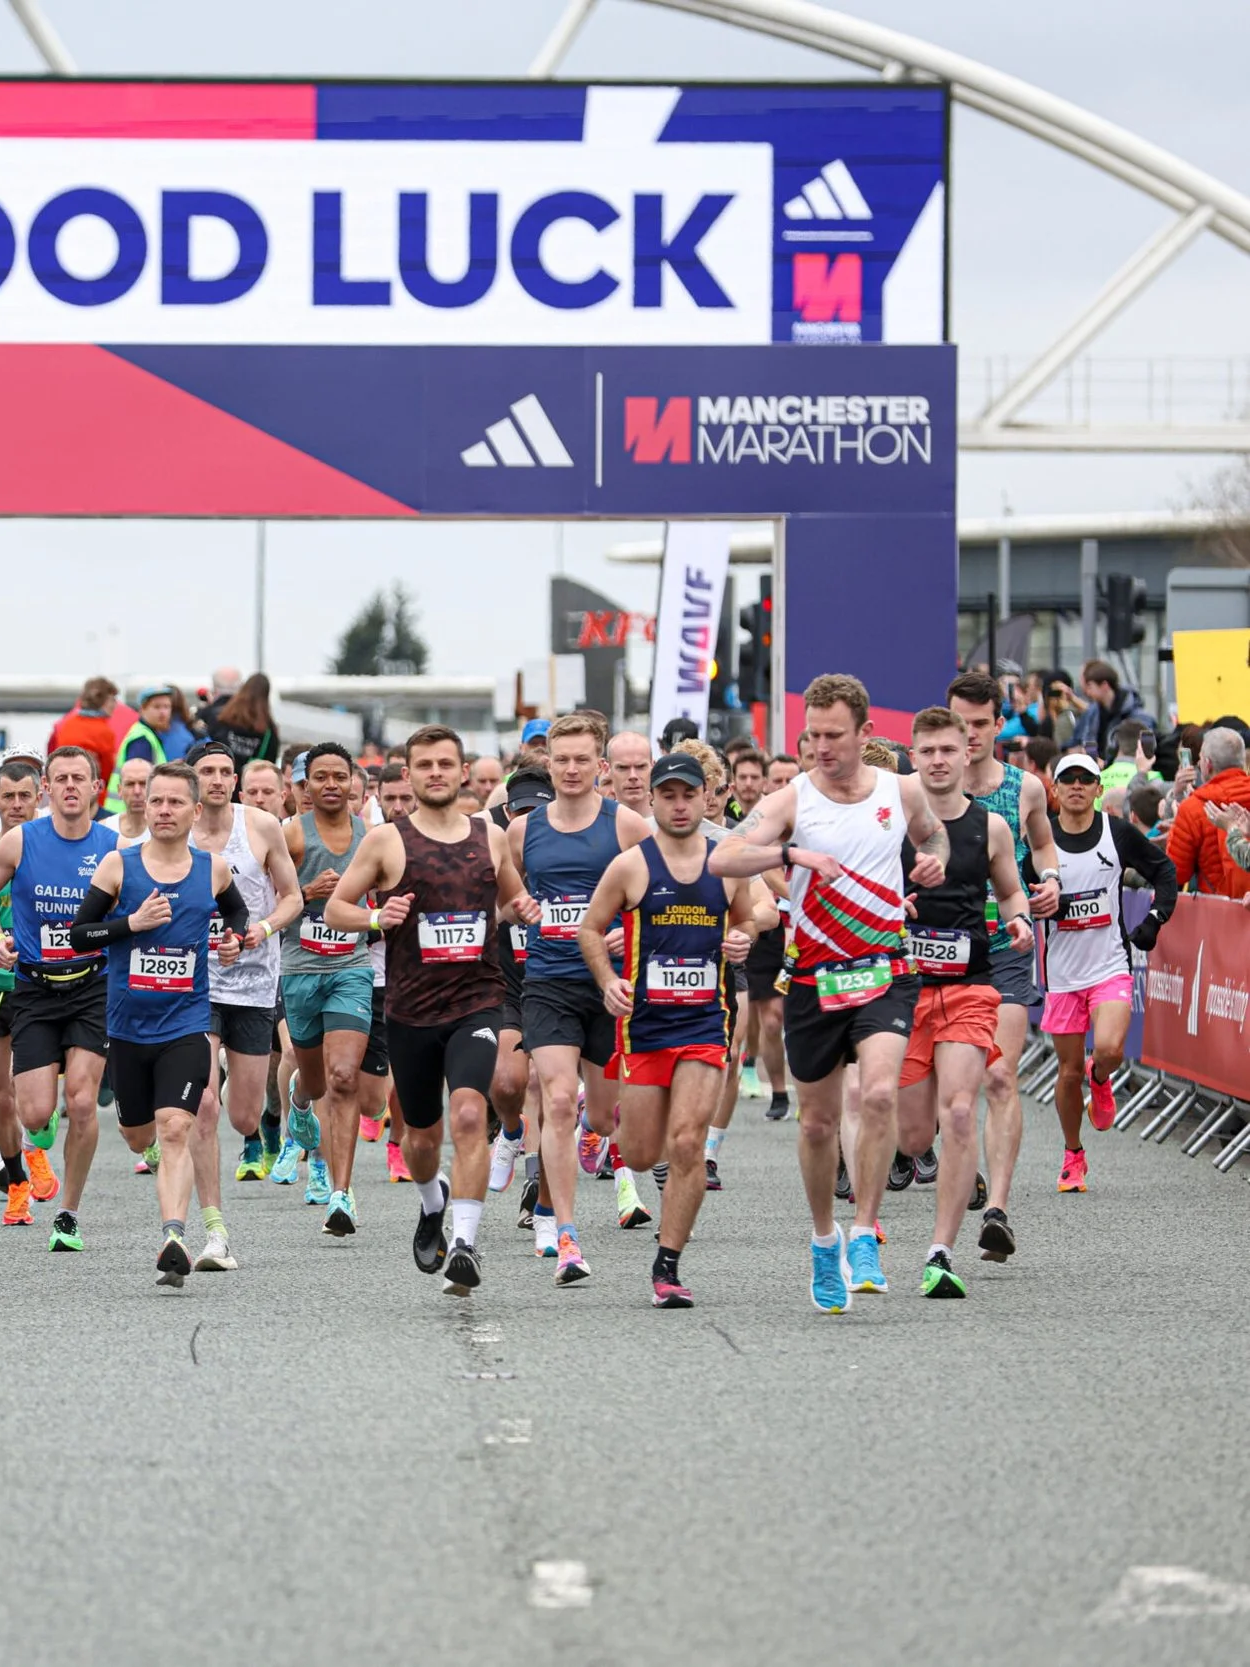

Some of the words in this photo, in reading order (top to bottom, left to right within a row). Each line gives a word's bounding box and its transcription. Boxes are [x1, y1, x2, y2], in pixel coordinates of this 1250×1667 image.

[312, 190, 737, 309] LUCK
[698, 396, 930, 425] MANCHESTER
[698, 426, 931, 464] MARATHON
[34, 884, 85, 900] GALBAL
[35, 901, 80, 915] RUNNE
[665, 905, 707, 915] LONDON
[651, 914, 718, 927] HEATHSIDE
[87, 929, 109, 939] FUSION
[313, 926, 348, 941] 11412
[435, 928, 476, 944] 11173
[912, 941, 957, 960] 11528
[140, 958, 187, 975] 12893
[662, 971, 705, 987] 11401
[835, 972, 876, 991] 1232
